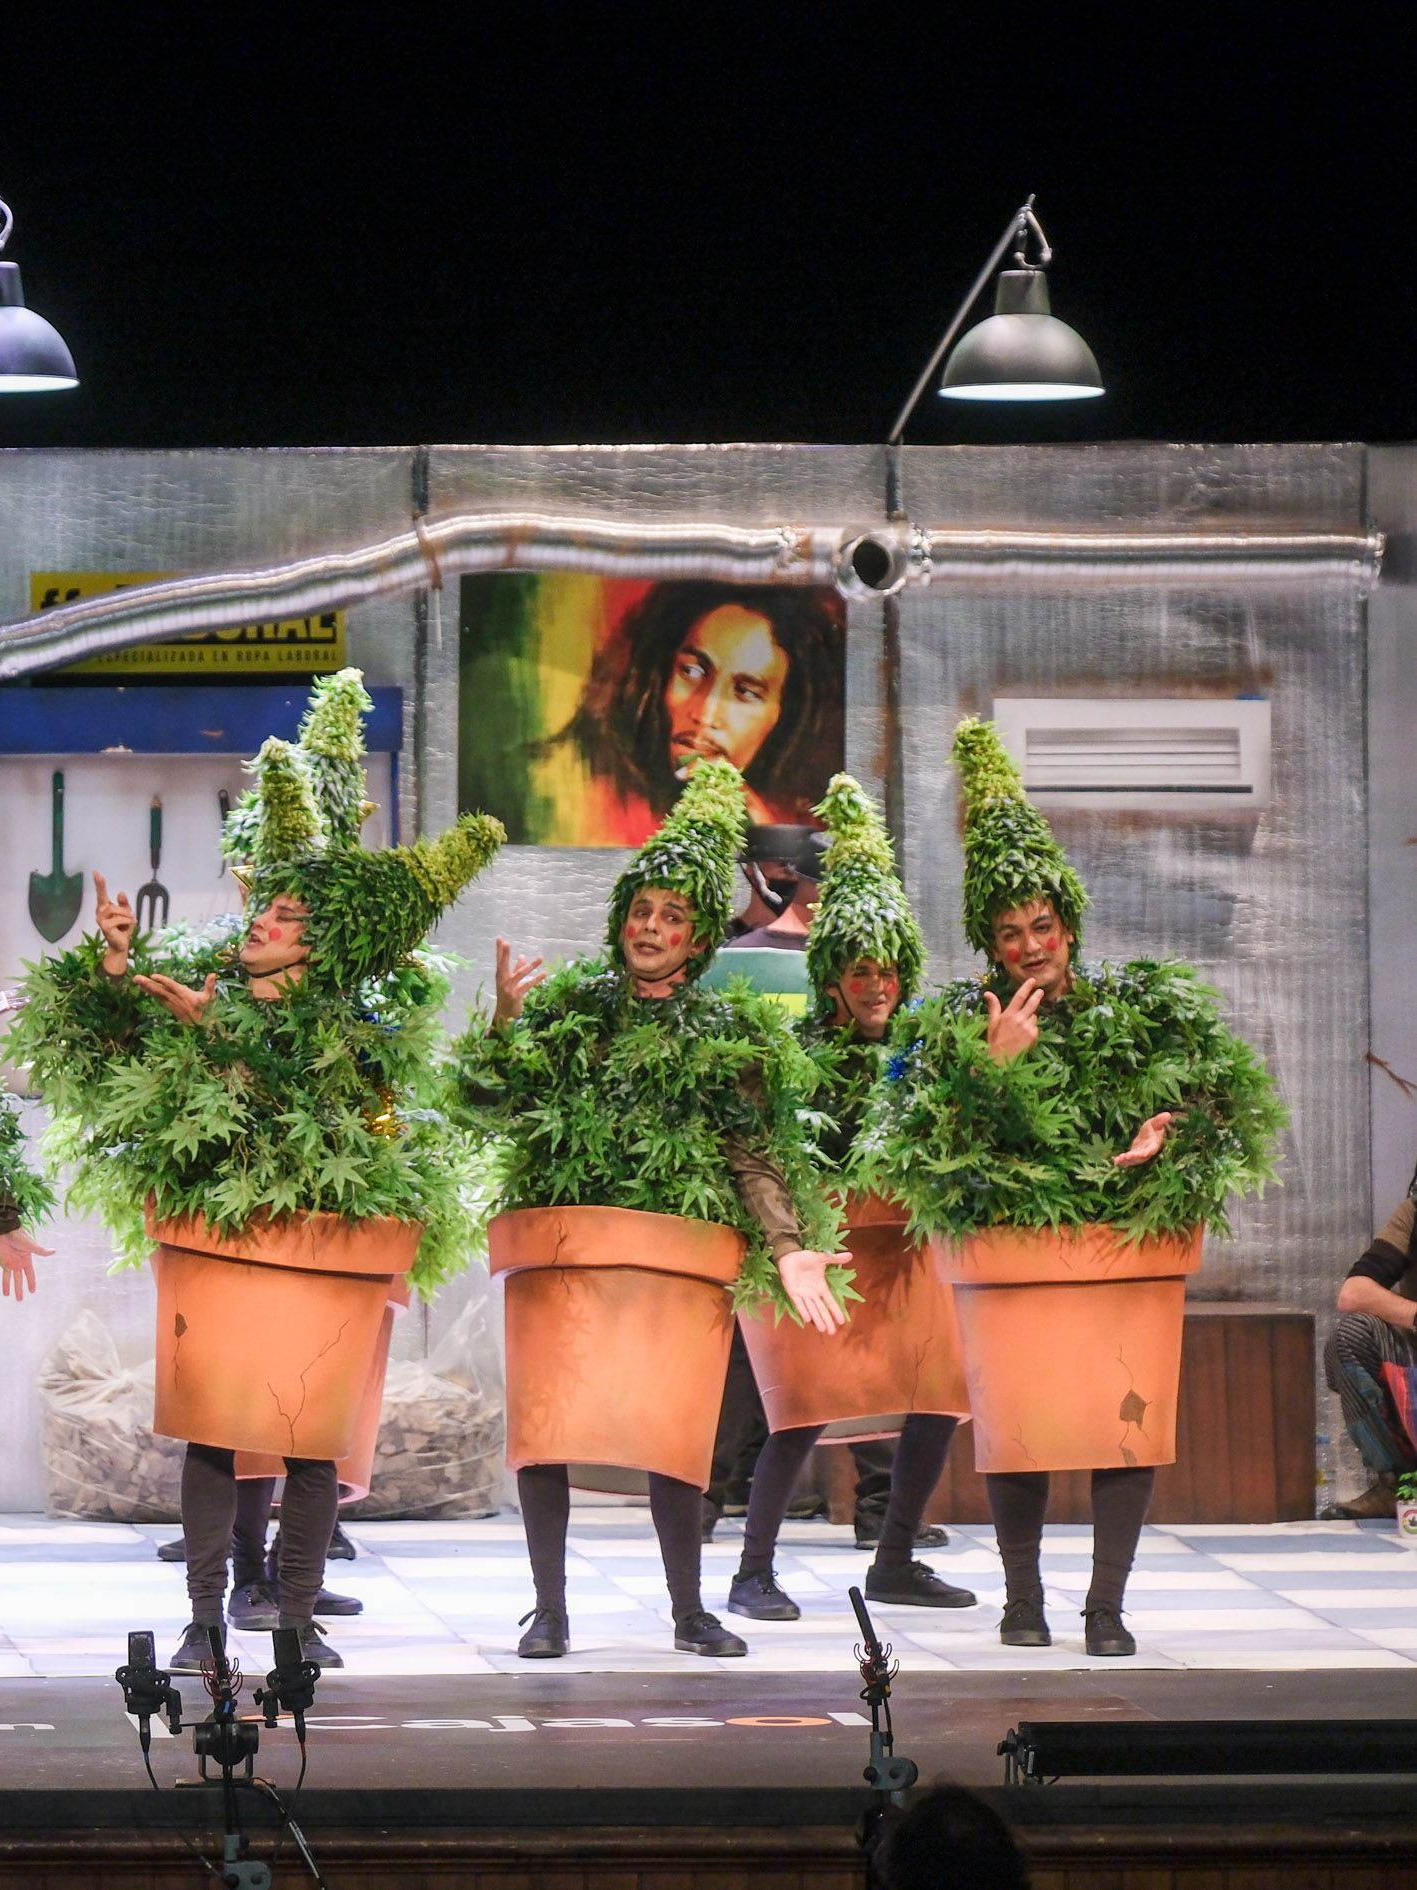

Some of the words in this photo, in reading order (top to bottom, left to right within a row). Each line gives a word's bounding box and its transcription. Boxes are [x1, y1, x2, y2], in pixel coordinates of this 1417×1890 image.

[212, 650, 229, 662] EN
[236, 650, 271, 662] ROPA
[278, 650, 337, 662] LABORAL
[275, 1712, 875, 1732] Cajasol
